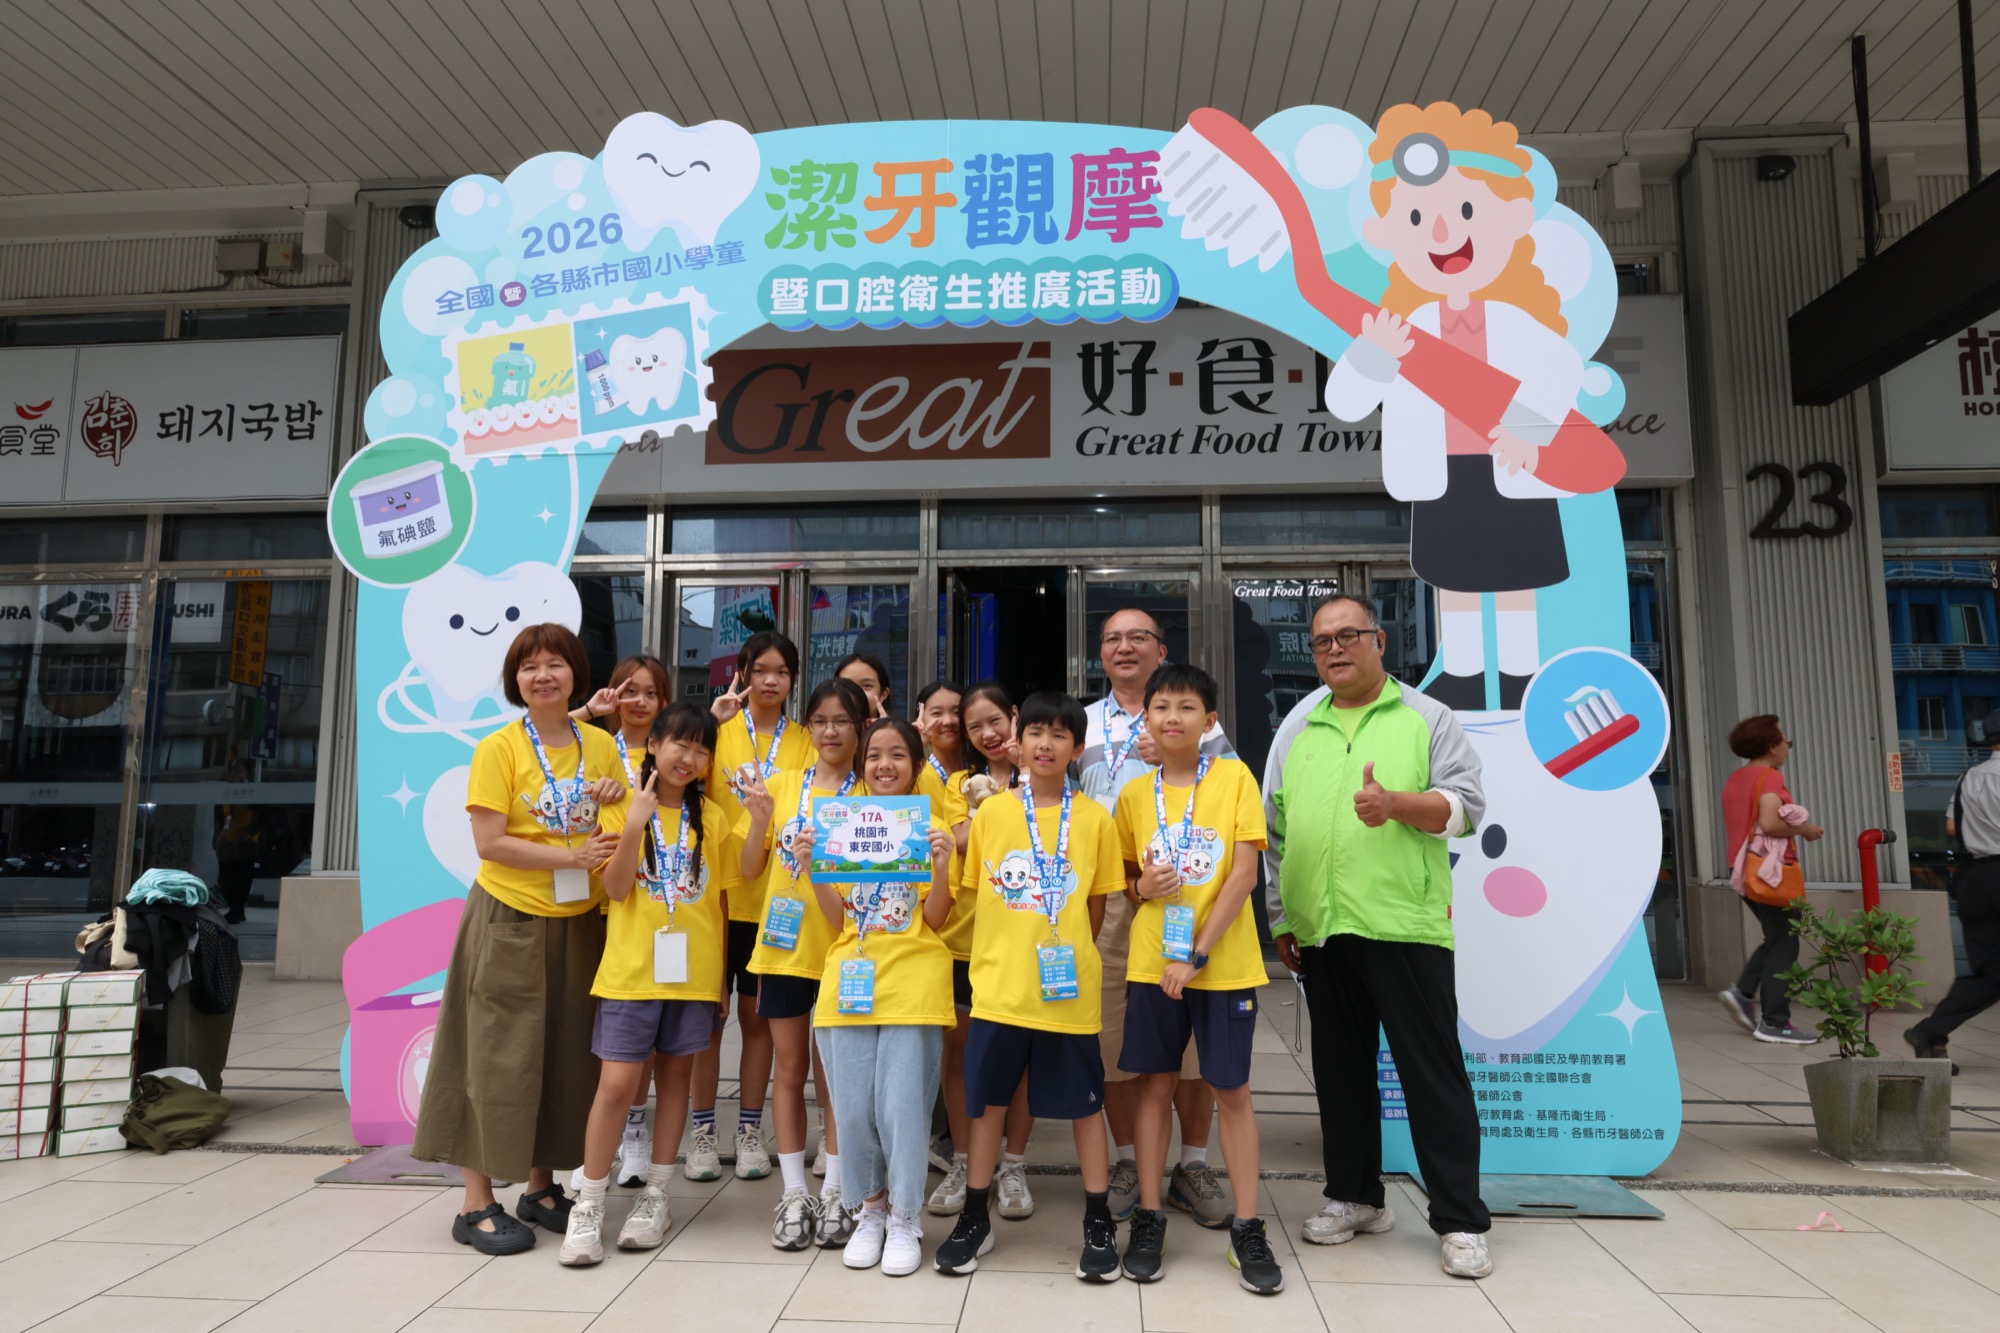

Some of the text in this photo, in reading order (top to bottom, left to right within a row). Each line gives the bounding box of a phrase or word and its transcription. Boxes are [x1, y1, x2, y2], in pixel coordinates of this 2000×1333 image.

[763, 147, 1163, 251] 潔牙觀摩
[521, 213, 623, 259] 2026
[770, 266, 1161, 315] 暨口腔衛生推廣活動
[597, 373, 615, 408] 1000 ppm
[716, 341, 1051, 456] Great
[156, 400, 323, 443] 돼지국밥
[1964, 402, 2000, 416] HO
[1075, 425, 1184, 456] Great
[1188, 424, 1283, 455] Food
[1746, 462, 1853, 539] 23
[377, 516, 437, 548] 氟碘鹽
[1234, 585, 1271, 598] Great
[1271, 585, 1304, 597] Food
[855, 826, 888, 838] 桃園市
[861, 812, 883, 823] 17A
[849, 841, 894, 853] 東安國小
[1382, 1053, 1394, 1062] 指
[1384, 1090, 1405, 1099] 承辦
